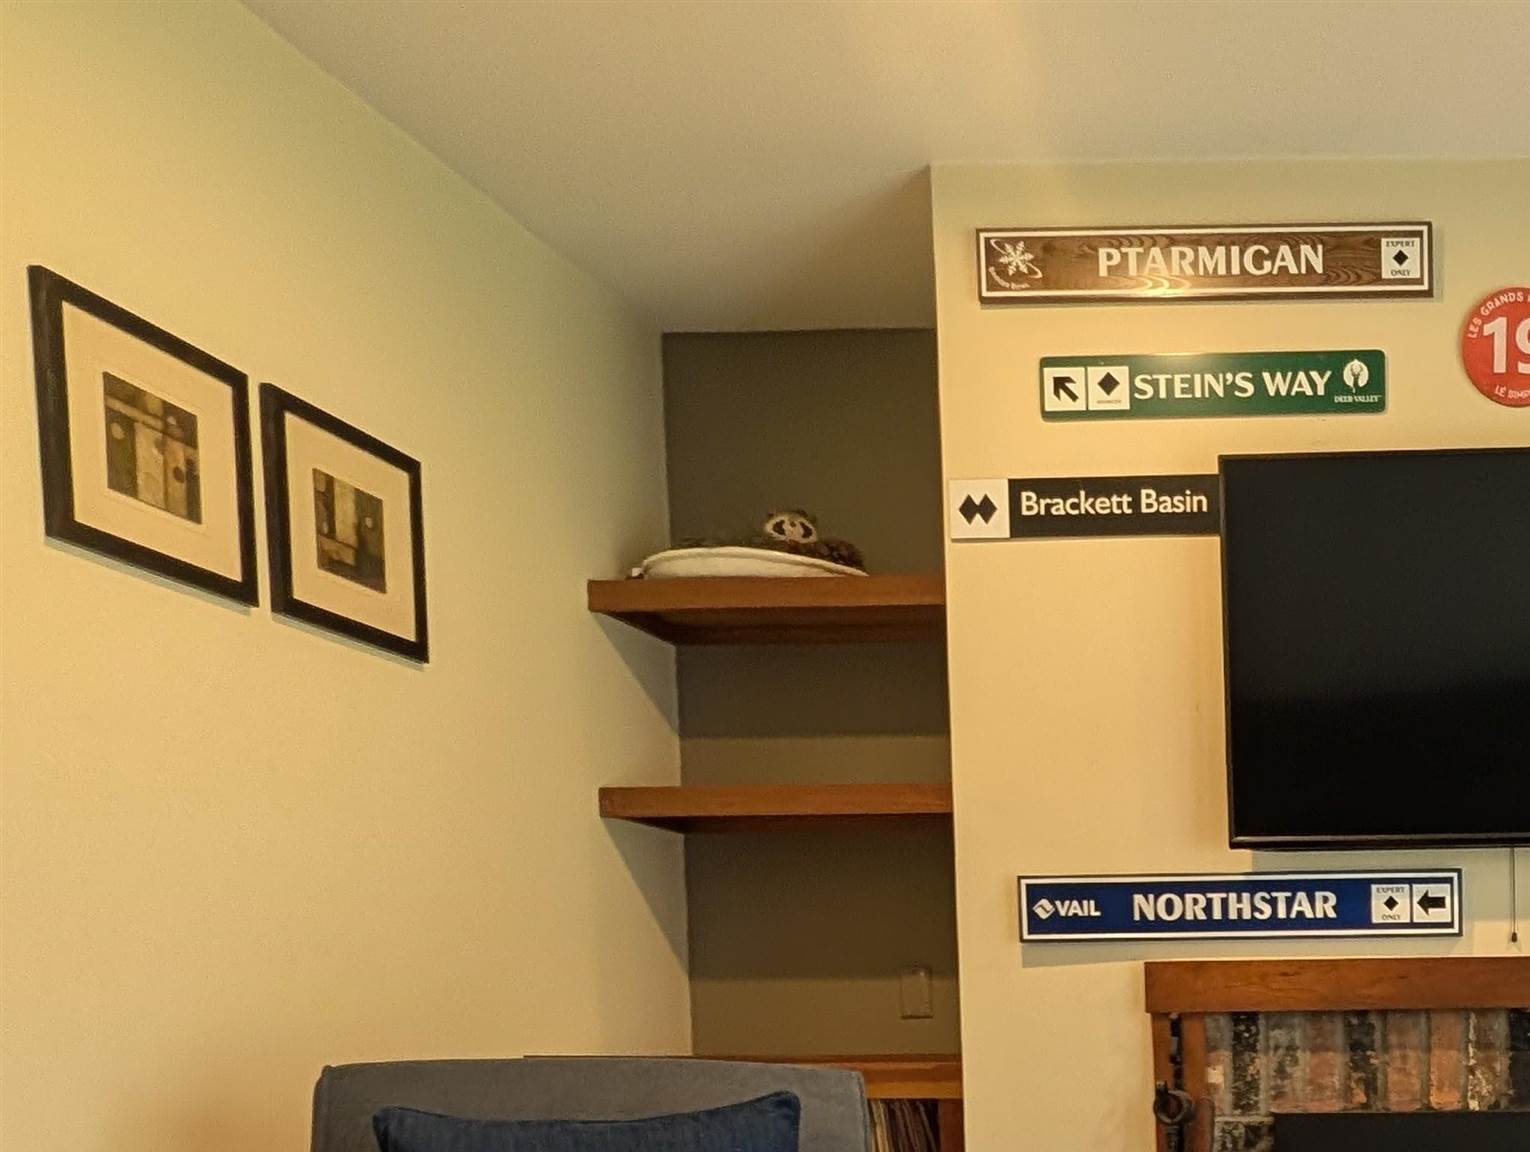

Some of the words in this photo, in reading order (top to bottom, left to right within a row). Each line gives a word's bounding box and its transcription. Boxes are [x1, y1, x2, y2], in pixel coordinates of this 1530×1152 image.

[1098, 244, 1324, 277] PTARMIGAN
[1467, 317, 1482, 339] LES
[1480, 291, 1524, 316] GRANDS
[1133, 371, 1256, 400] STEIN'S
[1262, 369, 1332, 397] WAY
[1495, 384, 1507, 398] LE
[1020, 490, 1133, 516] Brackett
[1140, 488, 1208, 514] Basin
[1053, 900, 1101, 918] VAIL
[1132, 890, 1338, 922] NORTHSTAR
